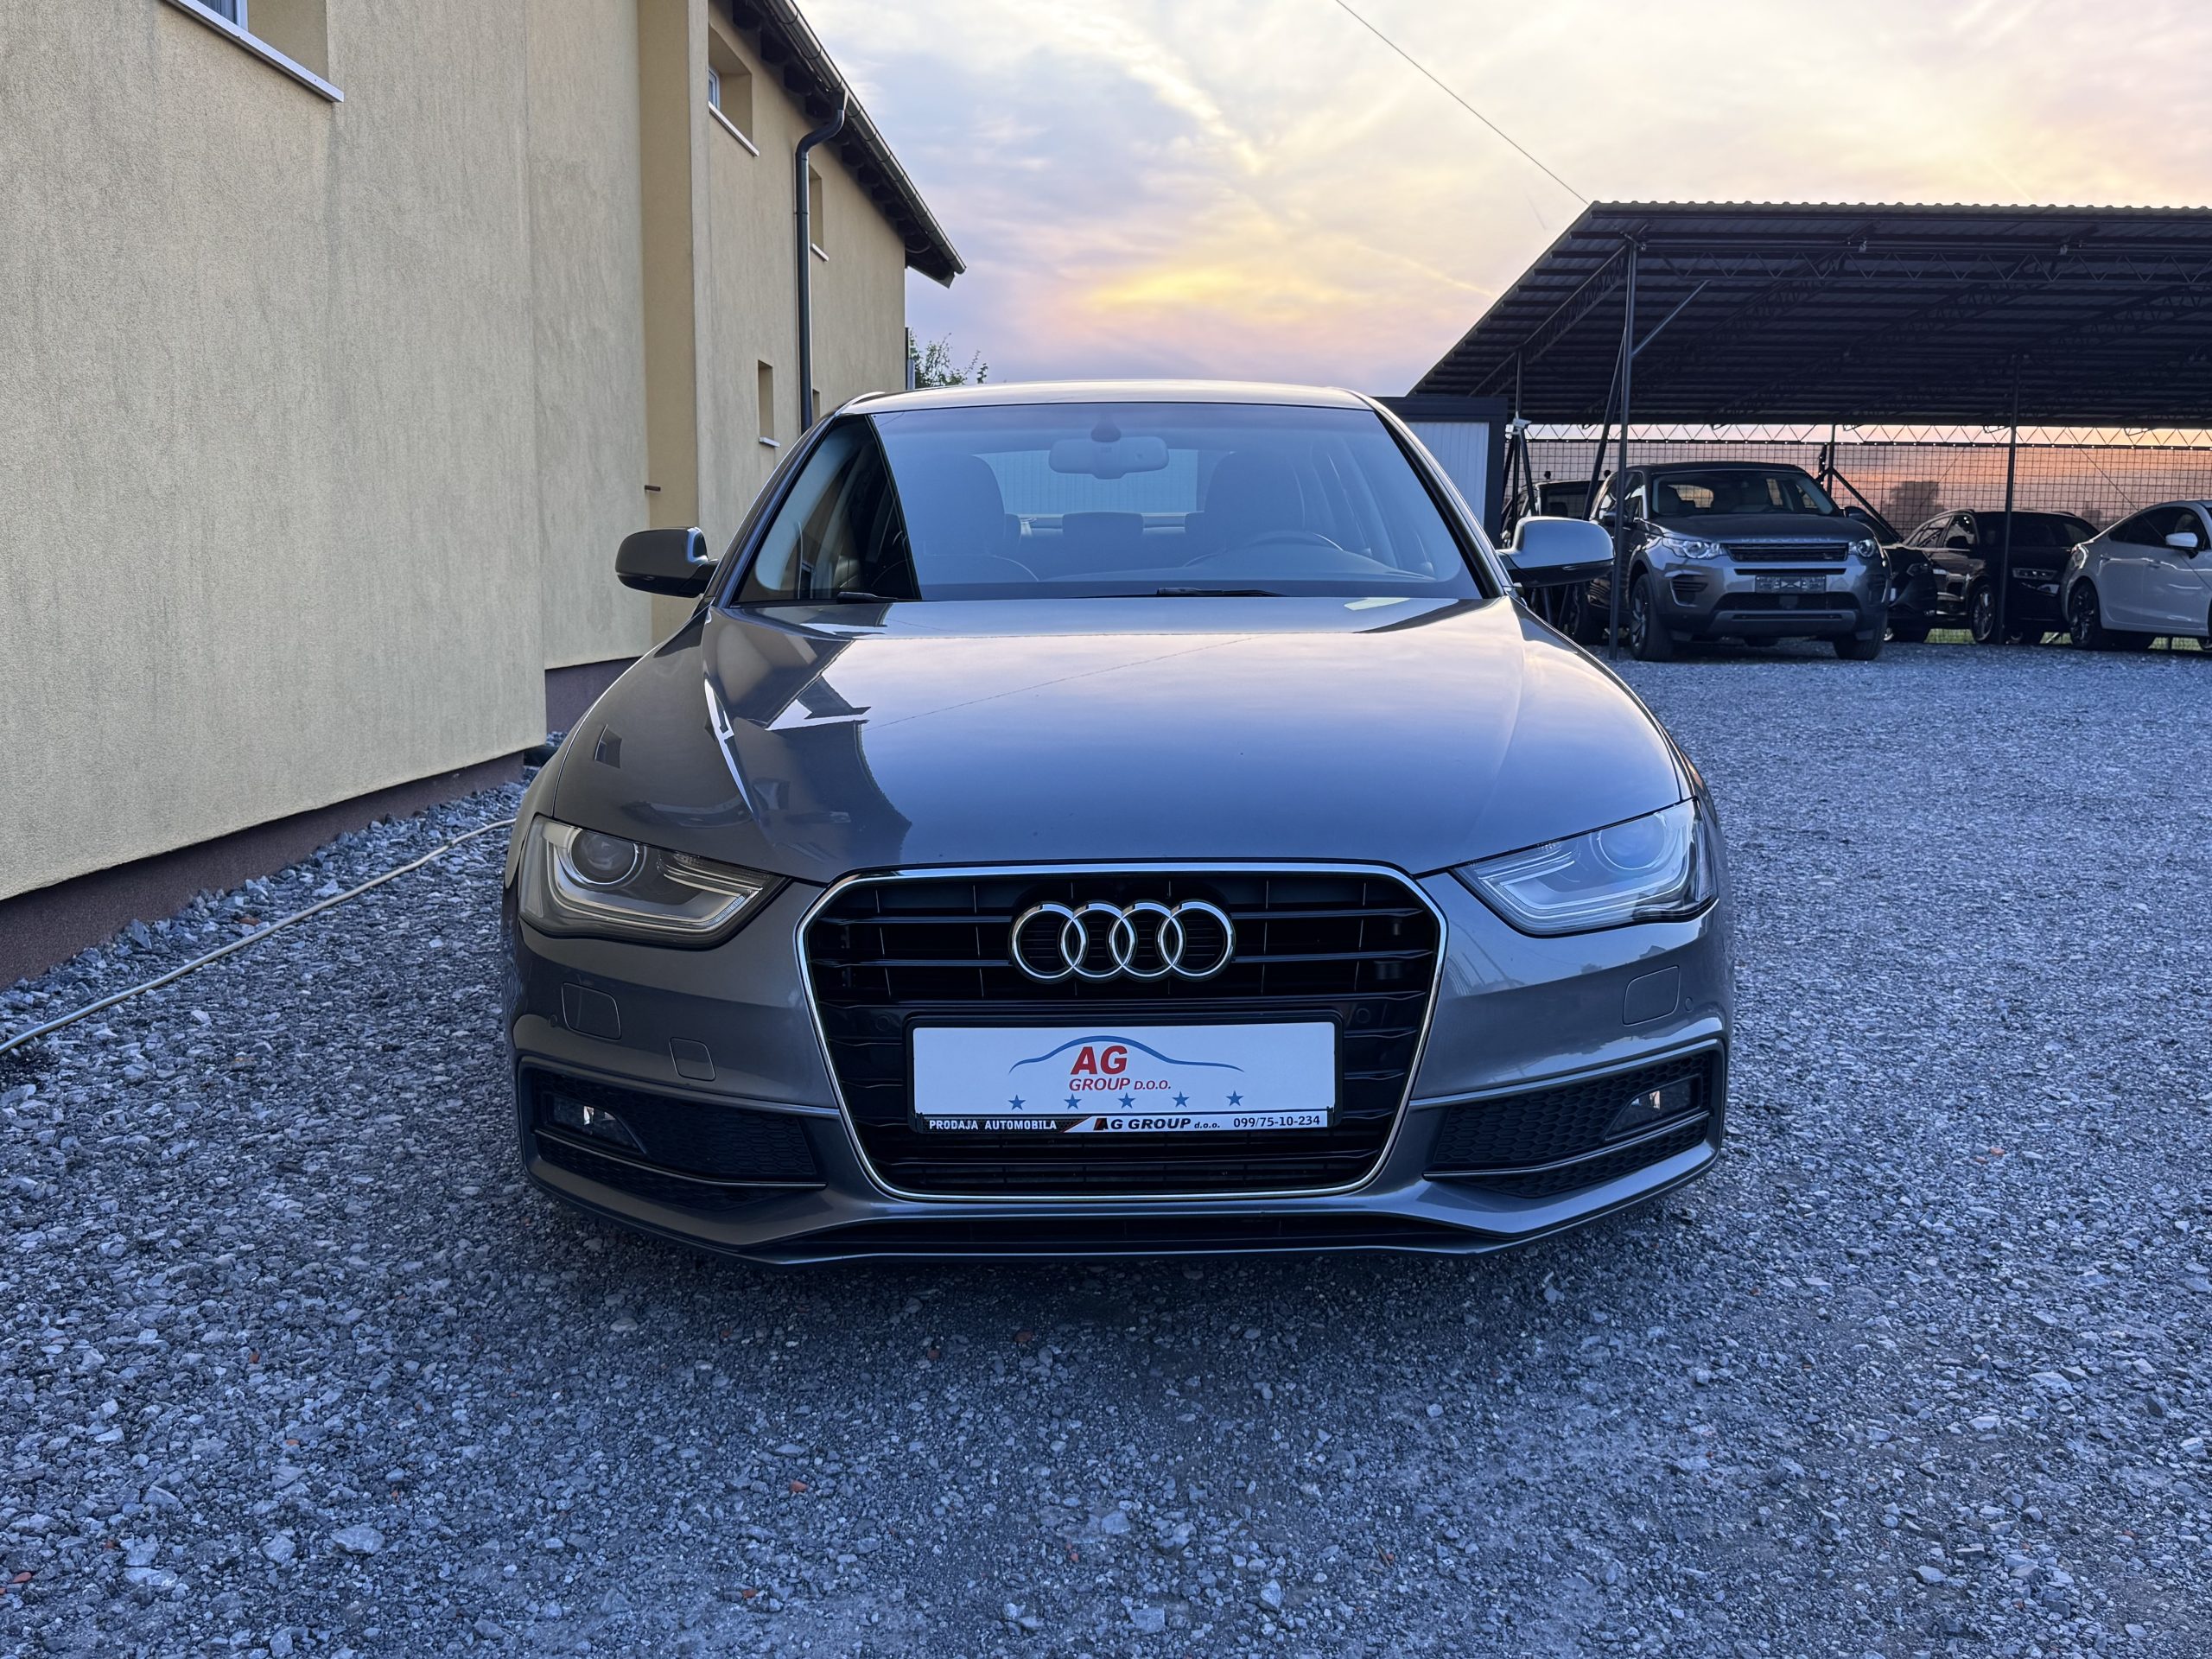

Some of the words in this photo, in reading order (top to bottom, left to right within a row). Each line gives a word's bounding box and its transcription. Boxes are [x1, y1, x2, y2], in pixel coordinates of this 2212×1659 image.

[1071, 1045, 1128, 1075] AG
[1069, 1077, 1130, 1090] GROUP
[1134, 1080, 1172, 1090] D.O.O.
[929, 1120, 978, 1130] PRODAJA
[984, 1120, 1057, 1130] AUTOMOBILA
[1128, 1118, 1192, 1130] GROUP
[1233, 1116, 1320, 1128] 099/75-10-234
